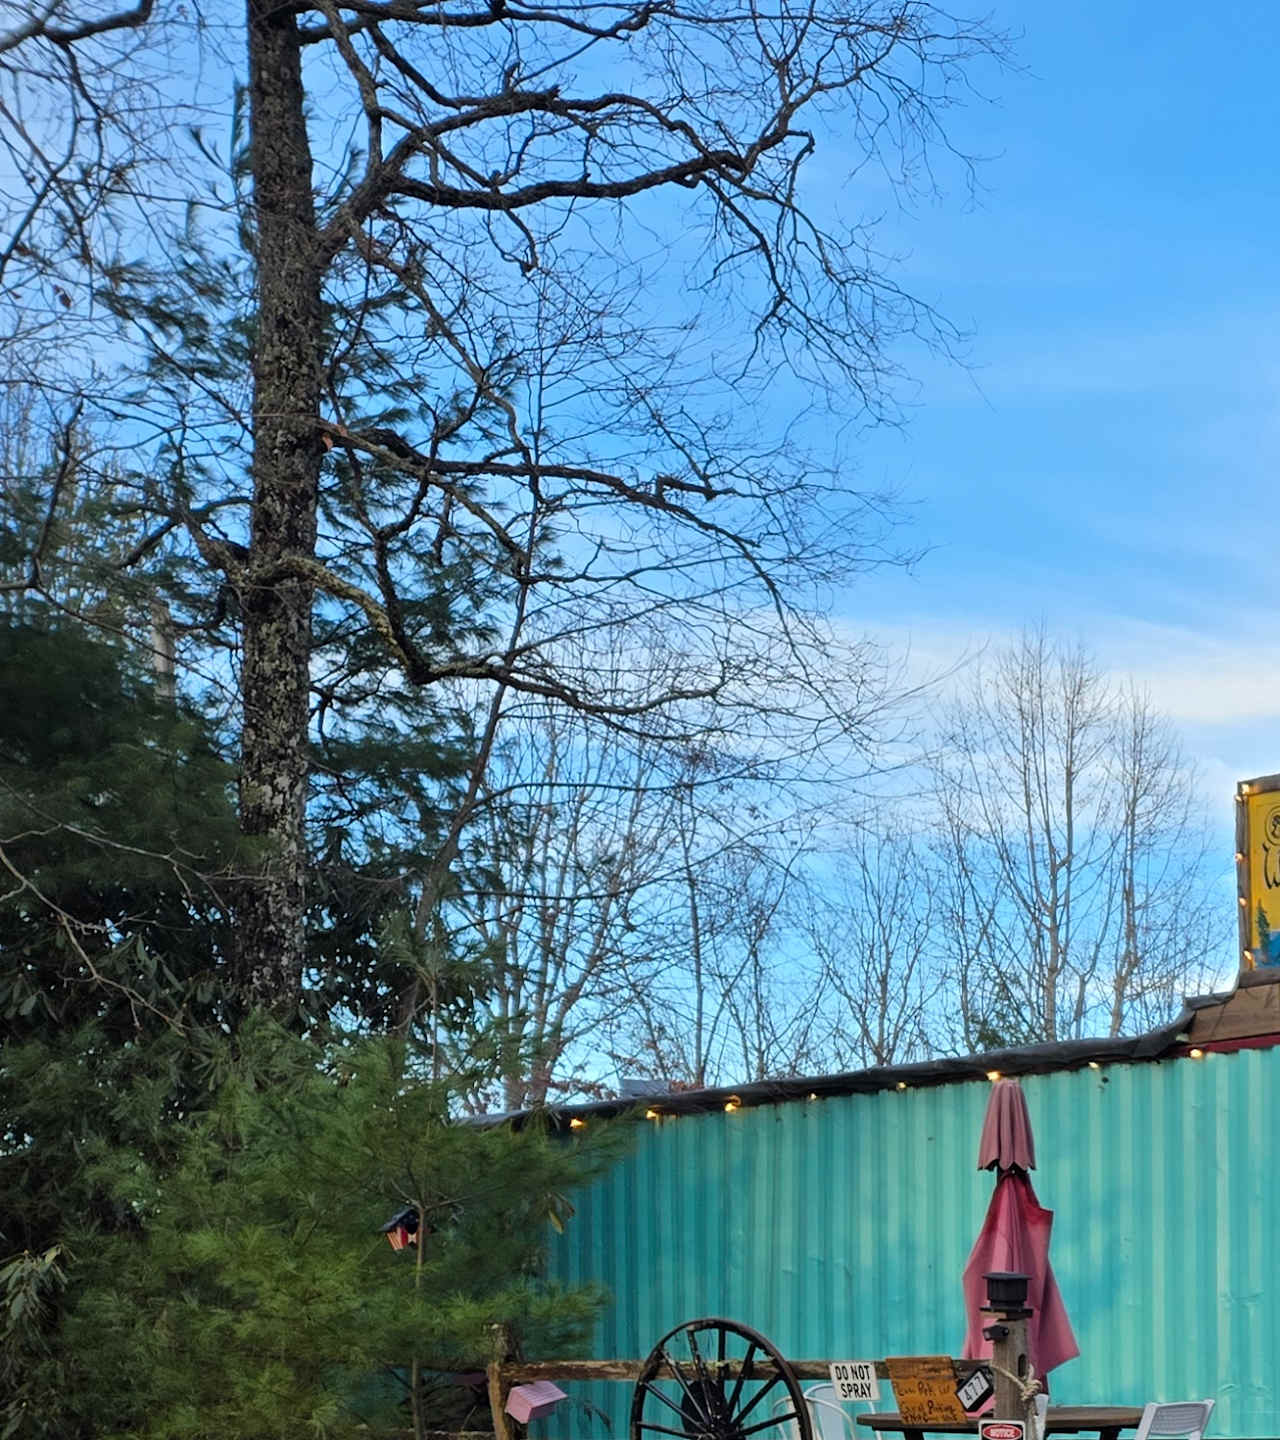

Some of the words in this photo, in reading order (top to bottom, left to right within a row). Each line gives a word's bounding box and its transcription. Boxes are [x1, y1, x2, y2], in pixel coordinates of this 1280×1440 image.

[834, 1366, 849, 1381] DO
[849, 1365, 870, 1380] NOT
[840, 1382, 873, 1398] SPRAY
